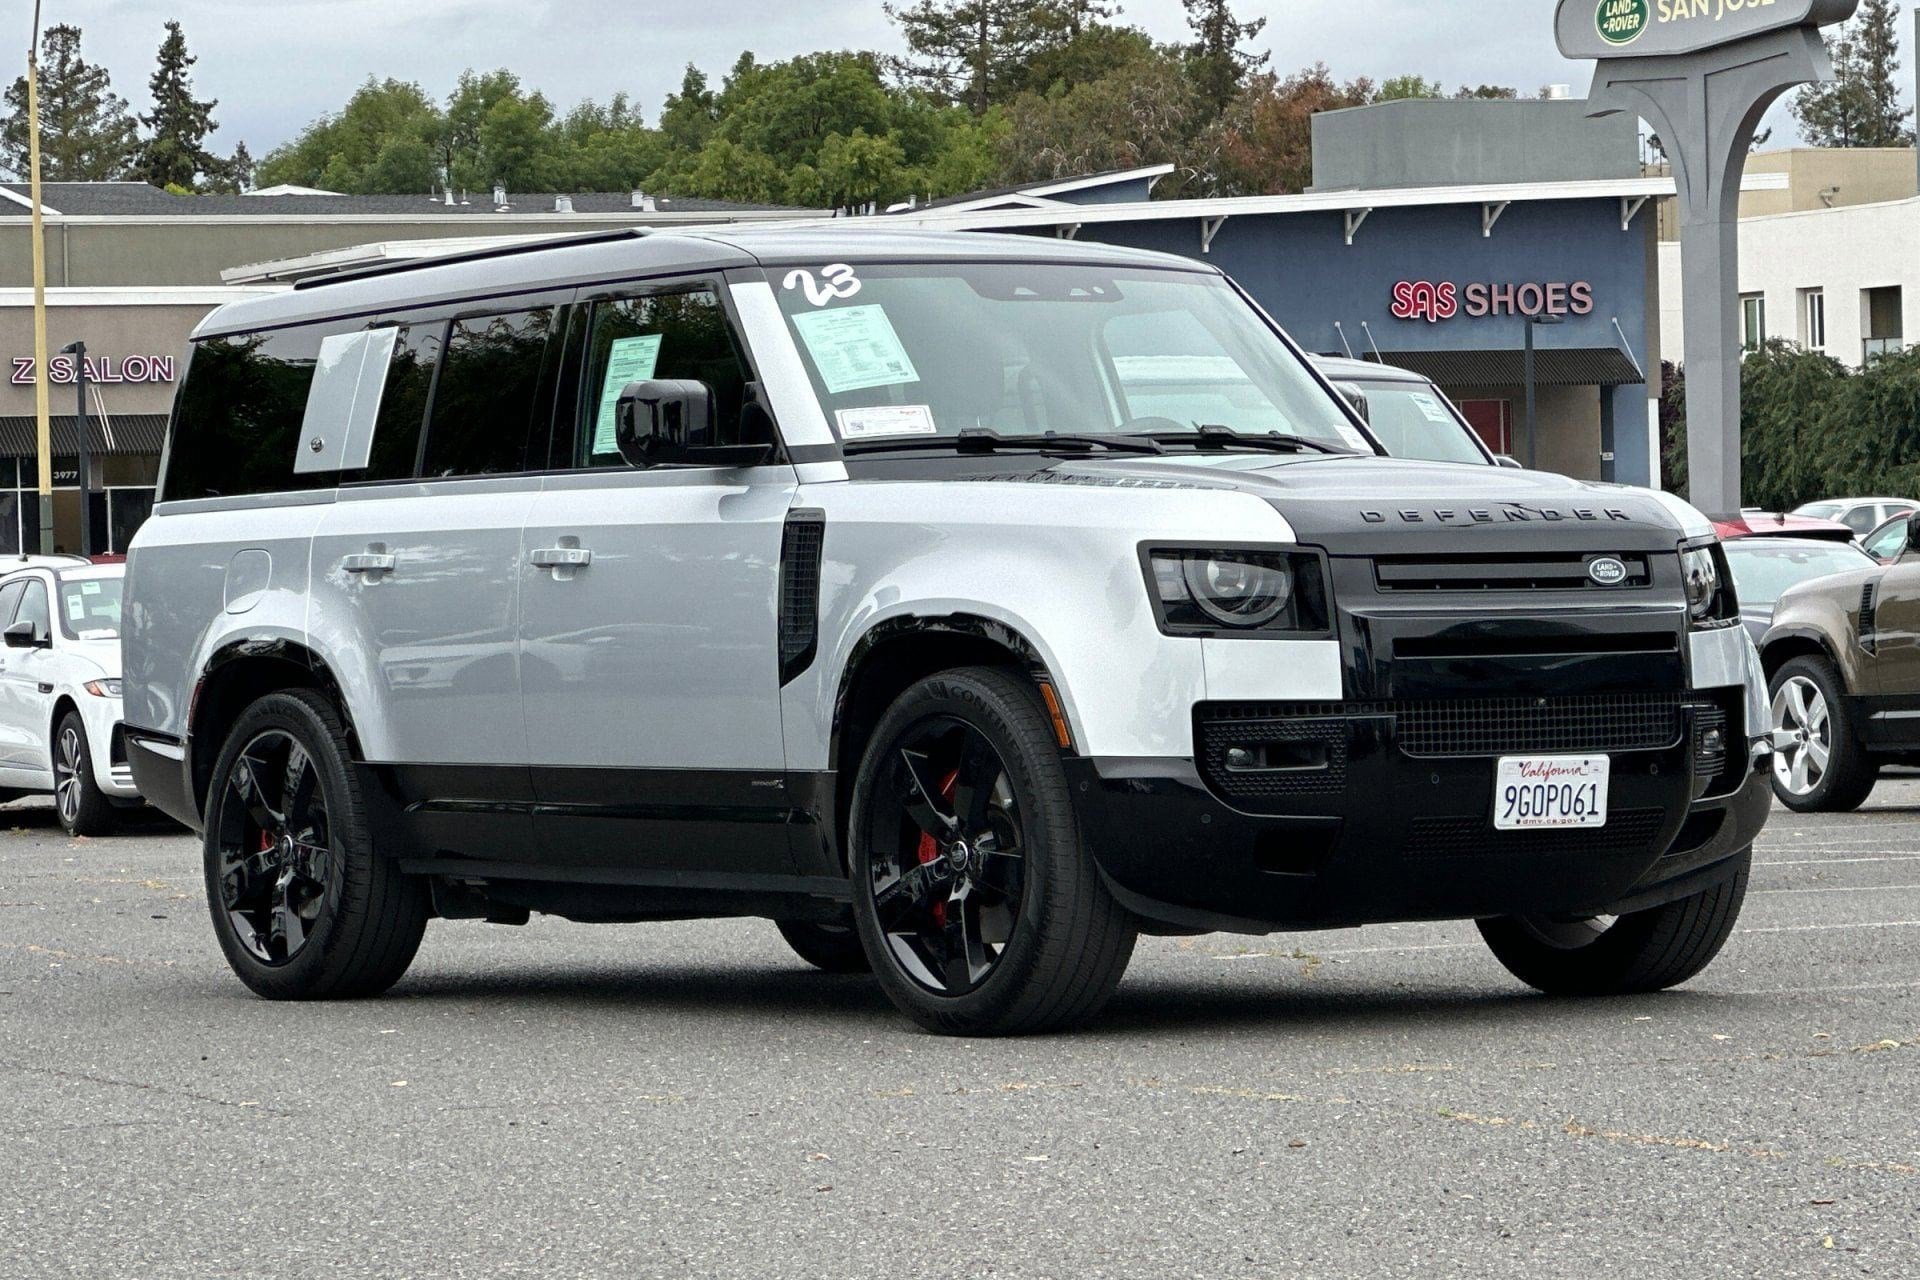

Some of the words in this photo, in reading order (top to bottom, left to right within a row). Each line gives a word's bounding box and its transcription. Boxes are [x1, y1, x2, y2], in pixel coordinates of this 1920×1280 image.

[1605, 0, 1631, 17] LAND
[1657, 0, 1709, 23] SAN
[1714, 0, 1776, 21] JO
[1608, 13, 1640, 33] ROVER
[782, 263, 862, 307] 23
[1391, 281, 1458, 323] SAS
[1465, 282, 1594, 316] SHOES
[11, 357, 37, 384] Z
[49, 355, 174, 384] SALON
[53, 470, 79, 480] 3977
[1360, 508, 1630, 523] DEFENDER
[1596, 562, 1614, 571] LAND
[1520, 760, 1589, 782] California
